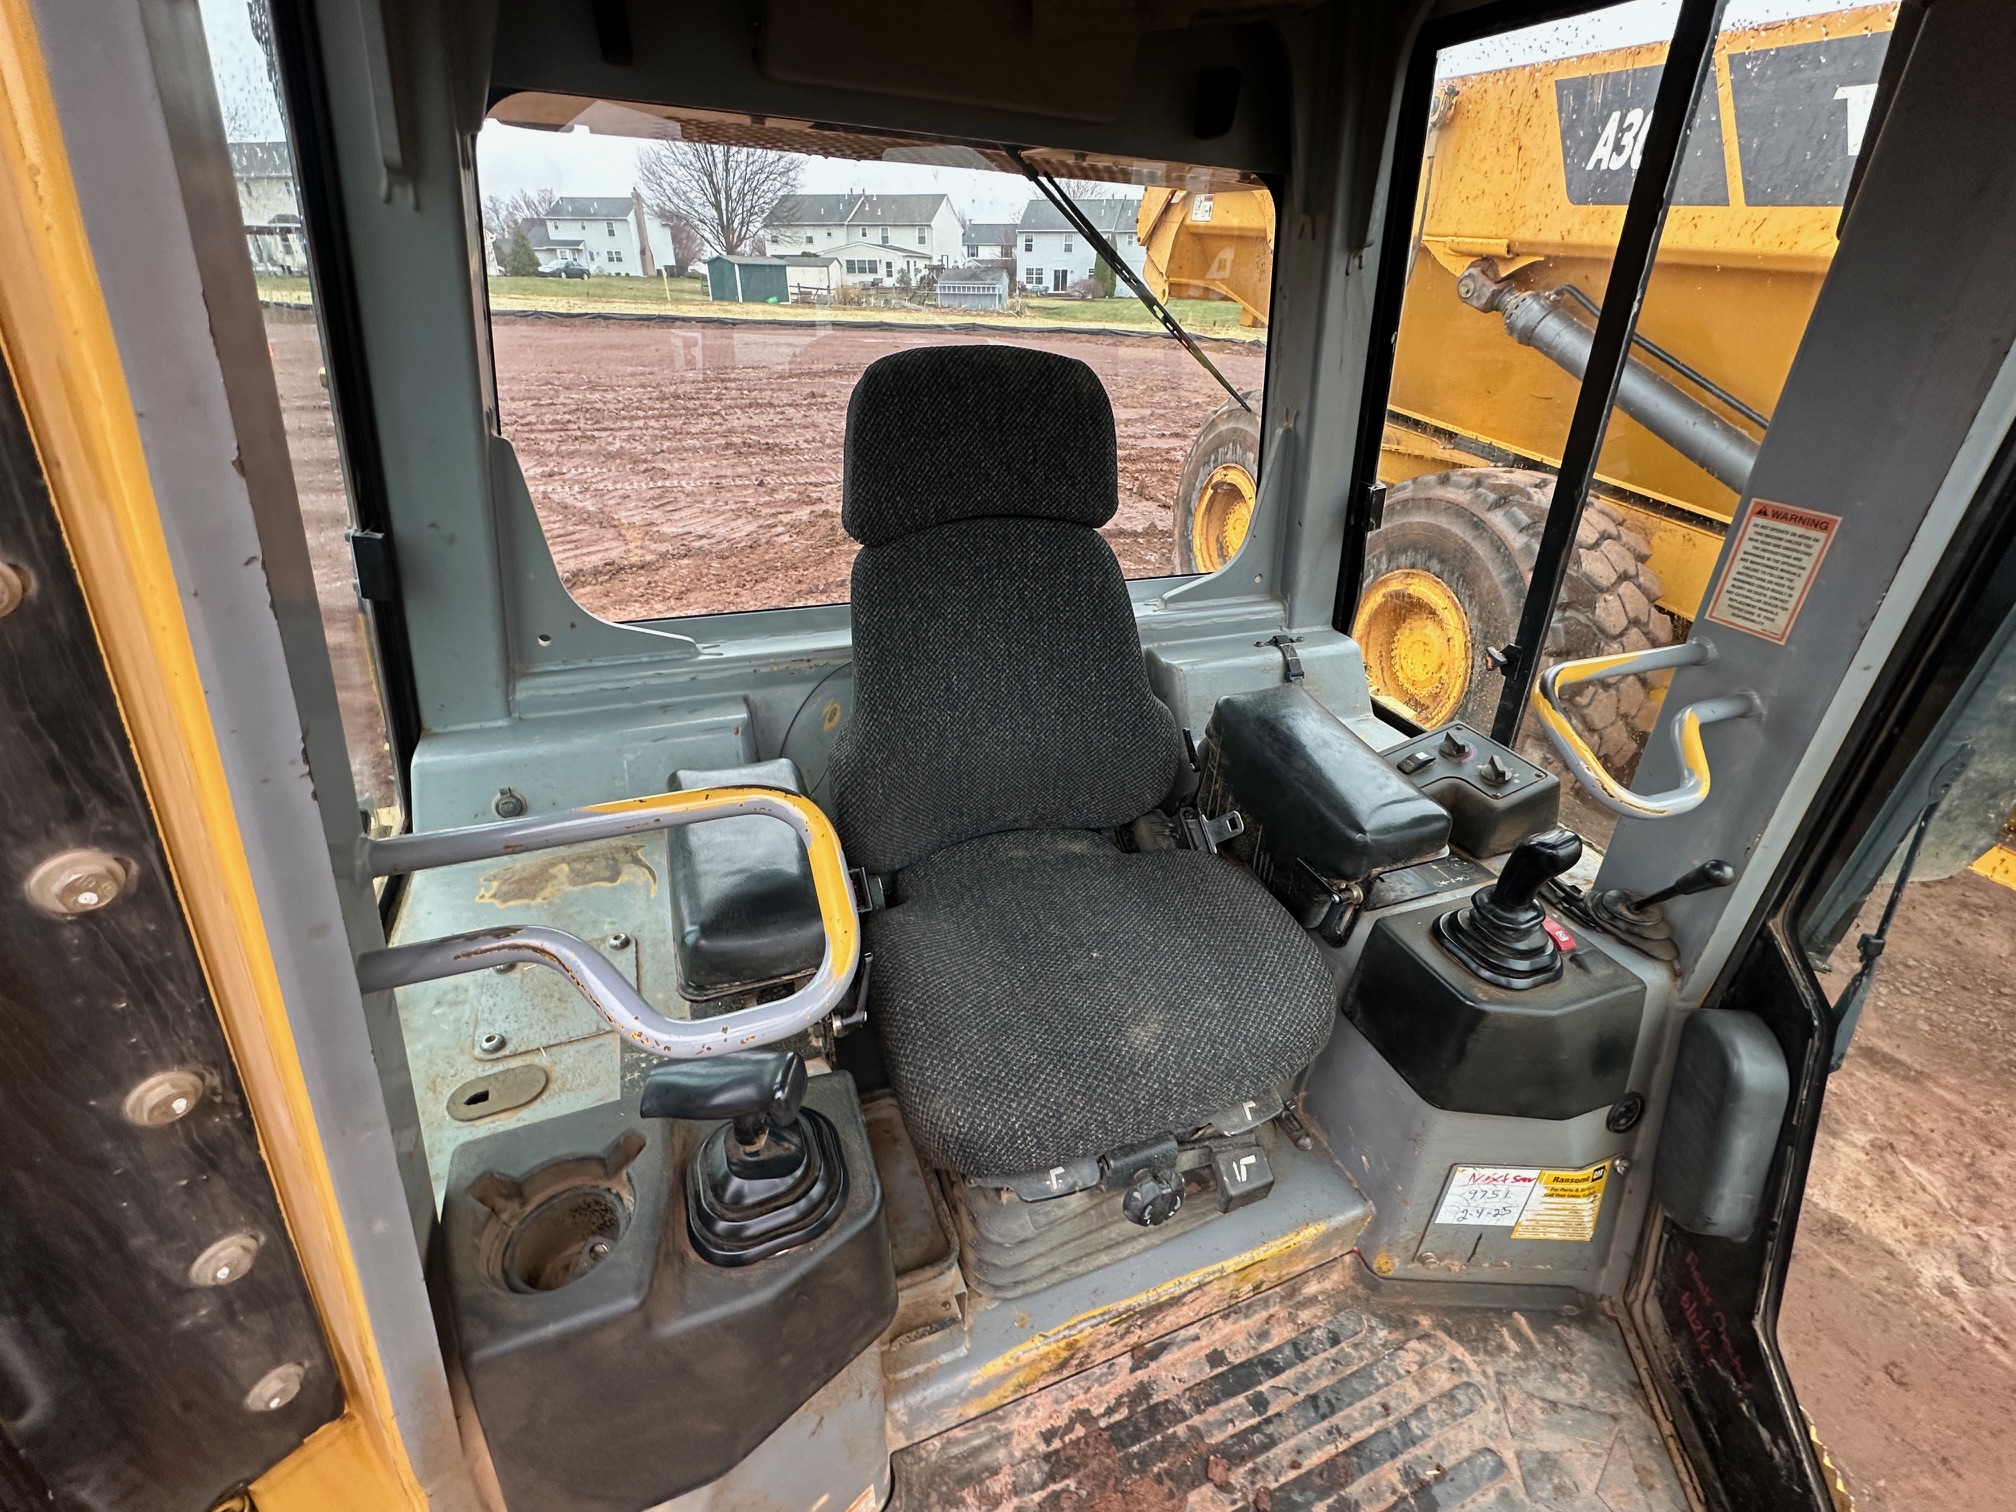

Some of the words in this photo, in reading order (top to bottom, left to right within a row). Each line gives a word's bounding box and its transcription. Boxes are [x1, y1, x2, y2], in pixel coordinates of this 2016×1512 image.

[1771, 509, 1830, 531] WARNING
[1469, 1173, 1510, 1184] Next
[1469, 1190, 1512, 1199] 9751
[1457, 1207, 1512, 1222] 2-4-25
